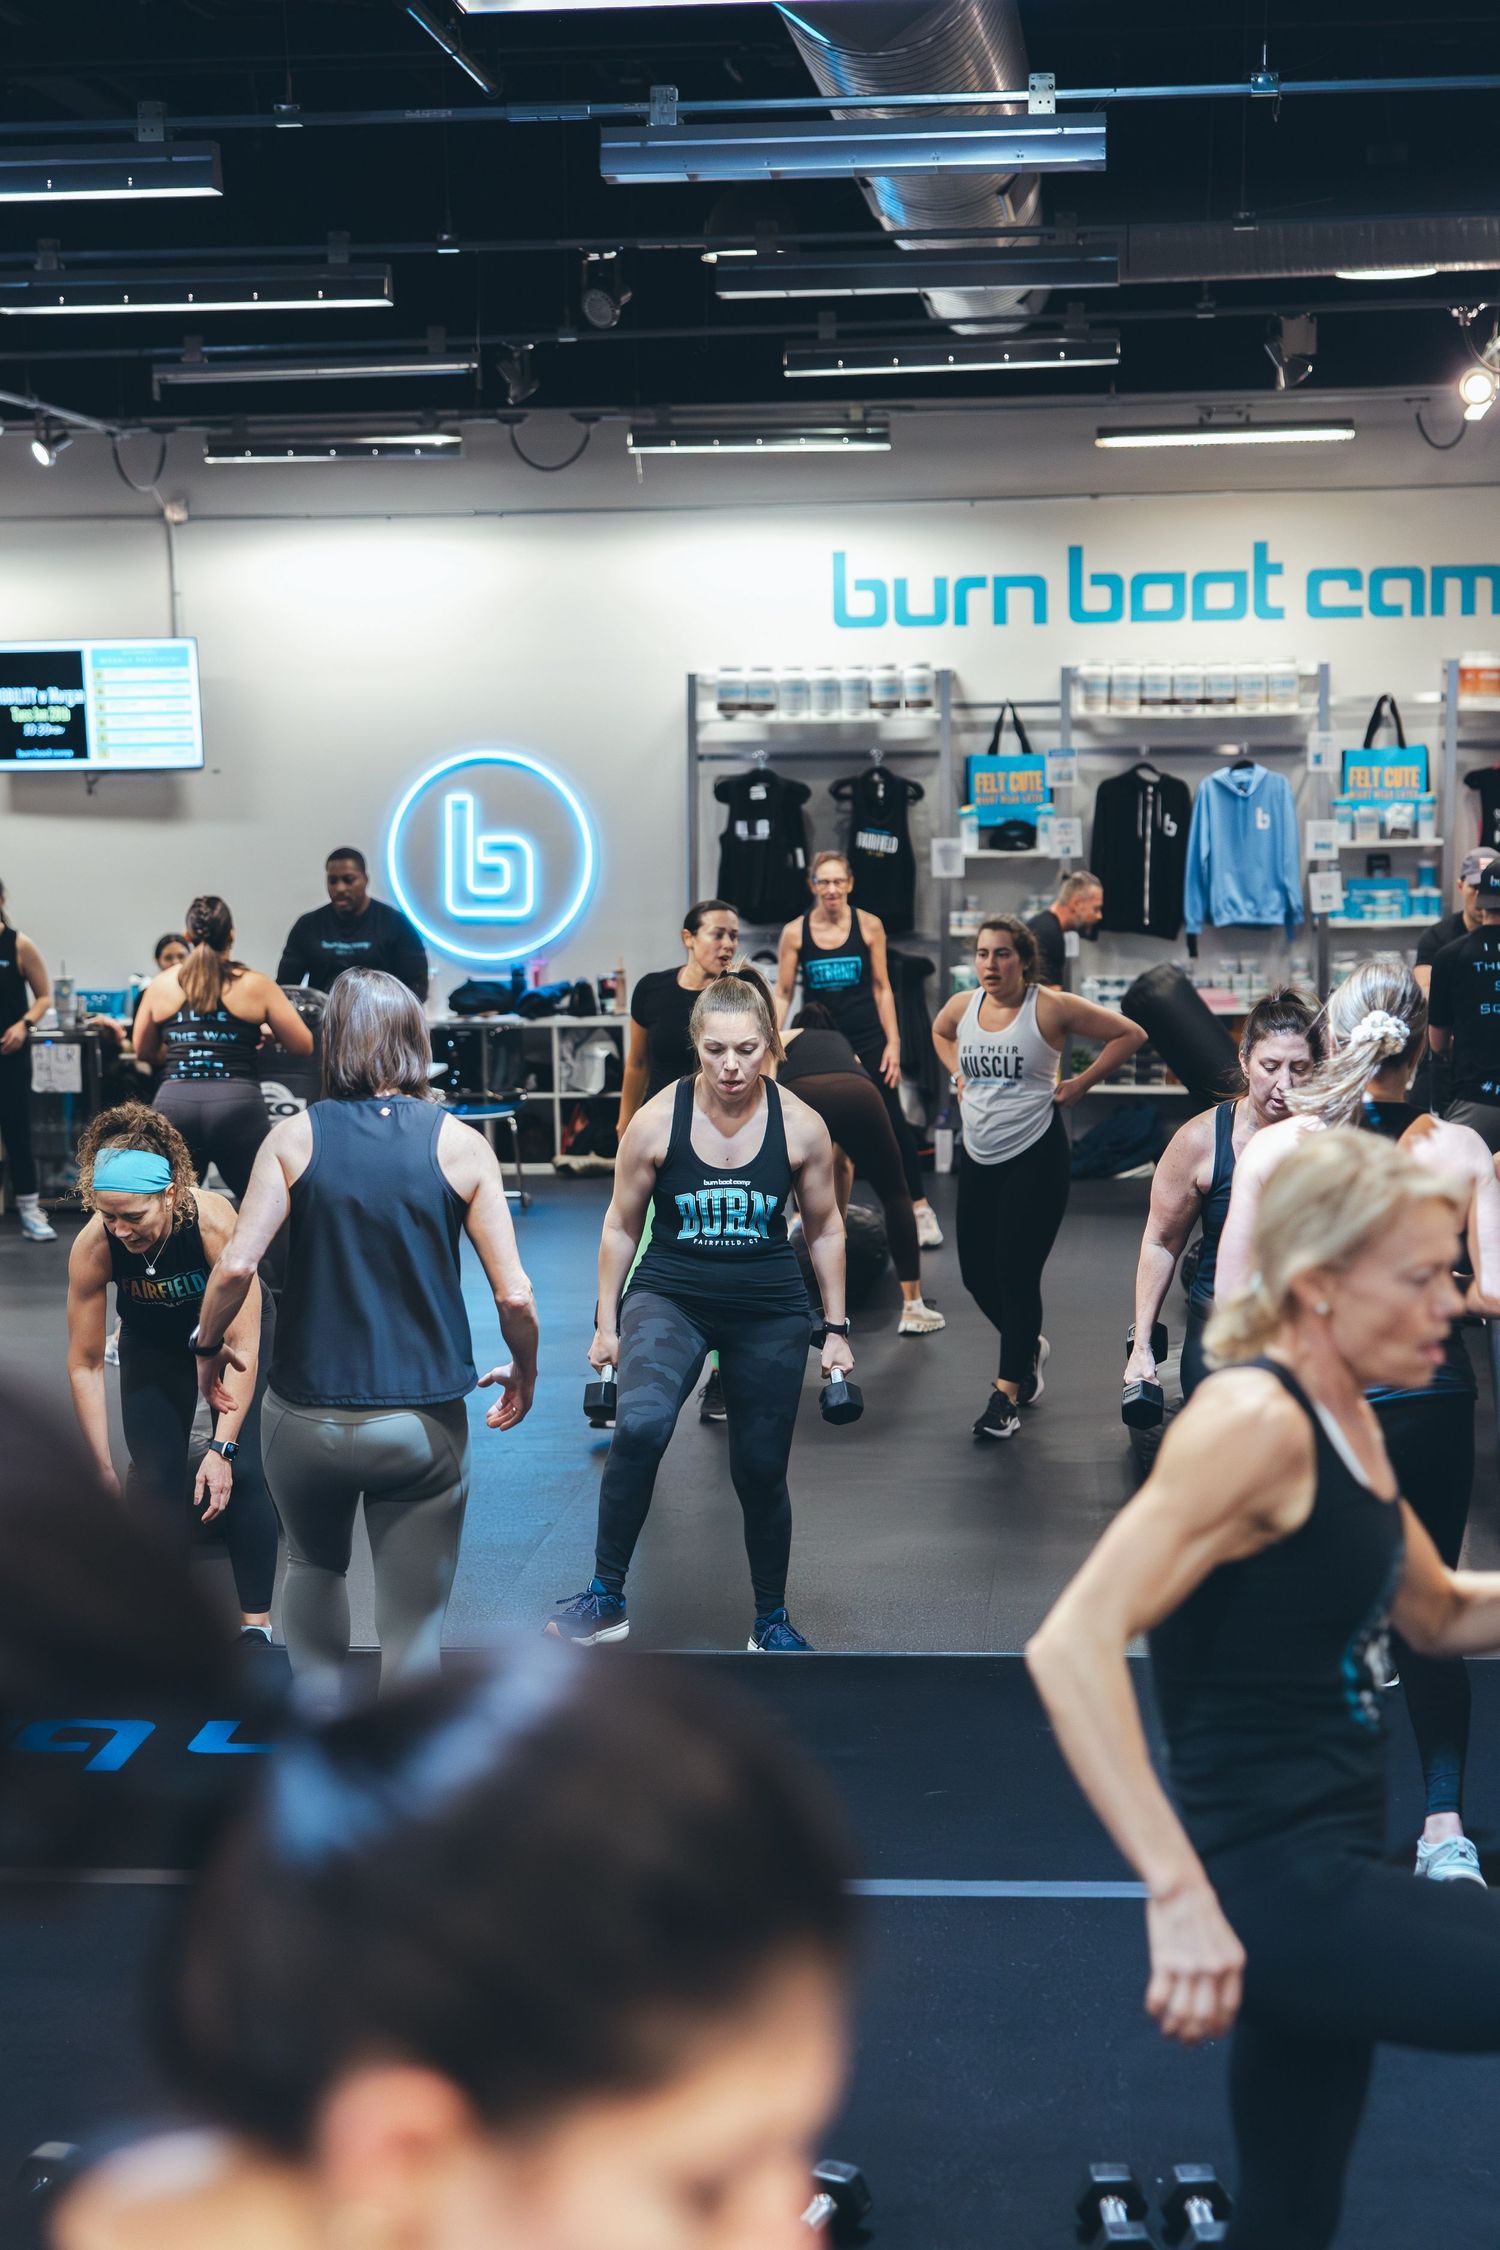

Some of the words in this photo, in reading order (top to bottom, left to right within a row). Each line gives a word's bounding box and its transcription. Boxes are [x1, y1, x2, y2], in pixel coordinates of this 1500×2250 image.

[833, 551, 1048, 628] burn
[1068, 541, 1285, 623] boot
[1306, 564, 1500, 618] cam
[974, 772, 1006, 793] FELT
[1010, 770, 1043, 791] CUTE
[1349, 766, 1381, 788] FELT
[1384, 766, 1419, 788] CUTE
[445, 794, 534, 917] b
[980, 1045, 1019, 1054] THEIR
[960, 1056, 1024, 1079] MUSCLE
[675, 1187, 778, 1240] BURN
[121, 1273, 206, 1299] FAIRFIELD
